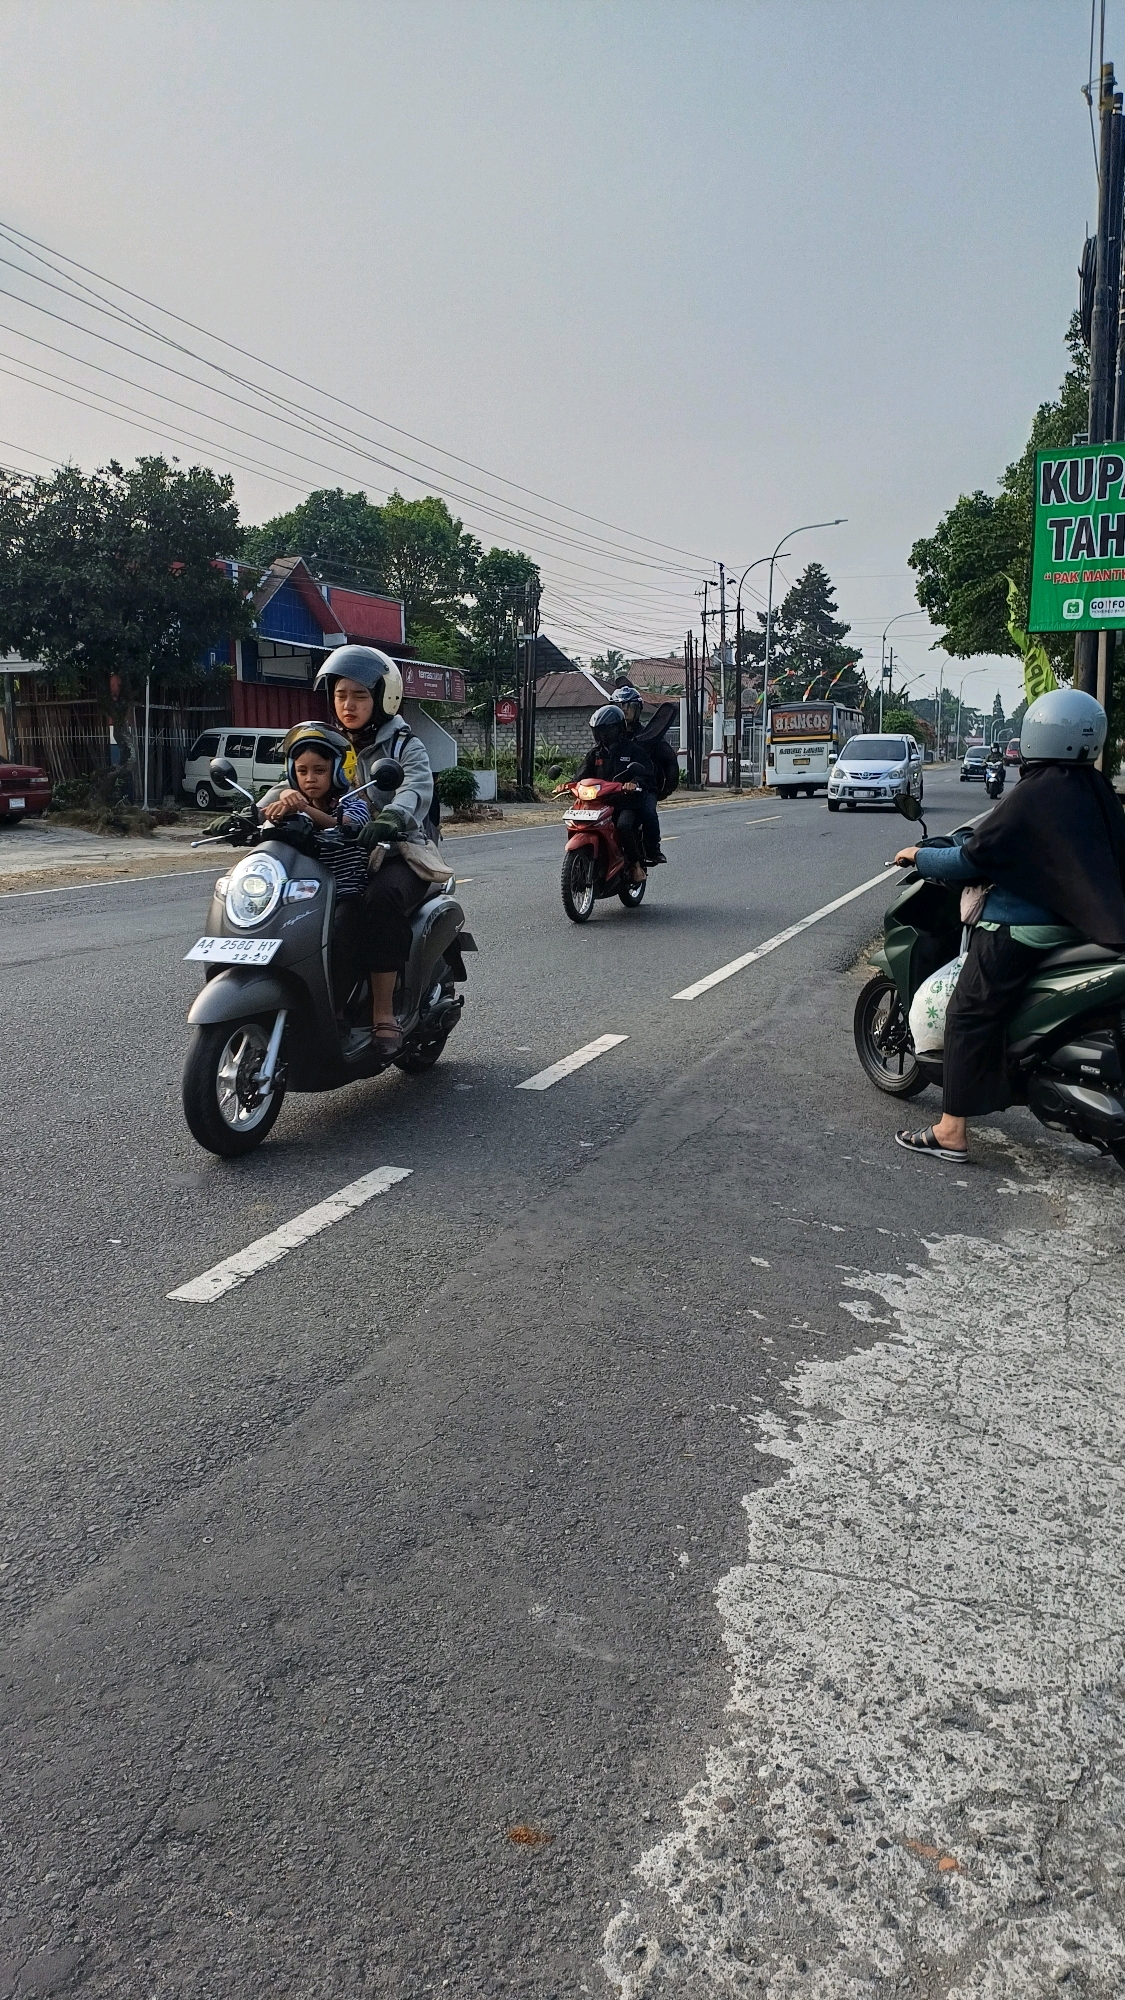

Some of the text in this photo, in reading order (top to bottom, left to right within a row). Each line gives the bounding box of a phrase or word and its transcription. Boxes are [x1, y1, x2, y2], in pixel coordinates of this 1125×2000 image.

[1040, 454, 1125, 506] KUP
[197, 939, 215, 949] AA
[257, 941, 277, 952] HY
